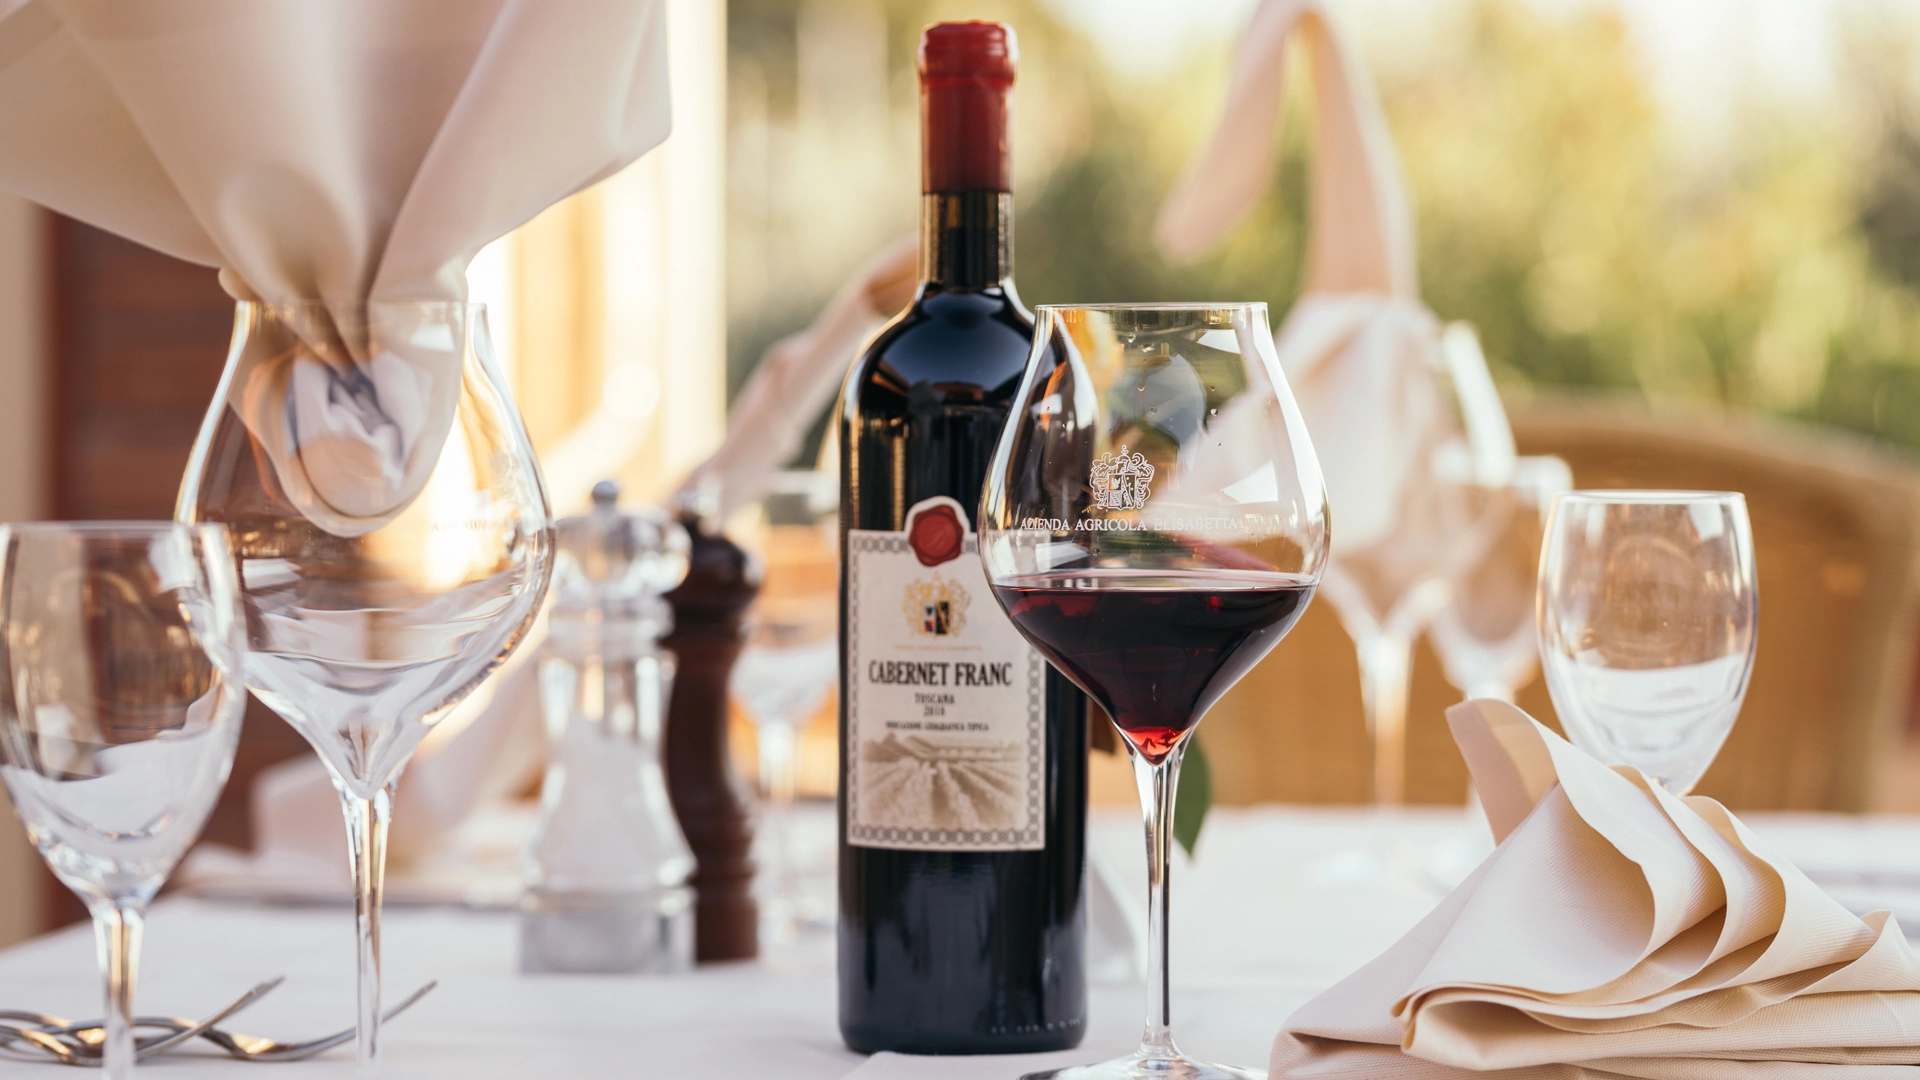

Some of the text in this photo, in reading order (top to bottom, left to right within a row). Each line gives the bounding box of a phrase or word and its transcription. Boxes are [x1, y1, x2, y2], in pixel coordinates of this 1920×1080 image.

[1020, 517, 1238, 531] AZIENDA AGRICOLA ELISABETTA
[868, 659, 1013, 687] CABERNET FRANC
[915, 692, 955, 705] TOSCANA
